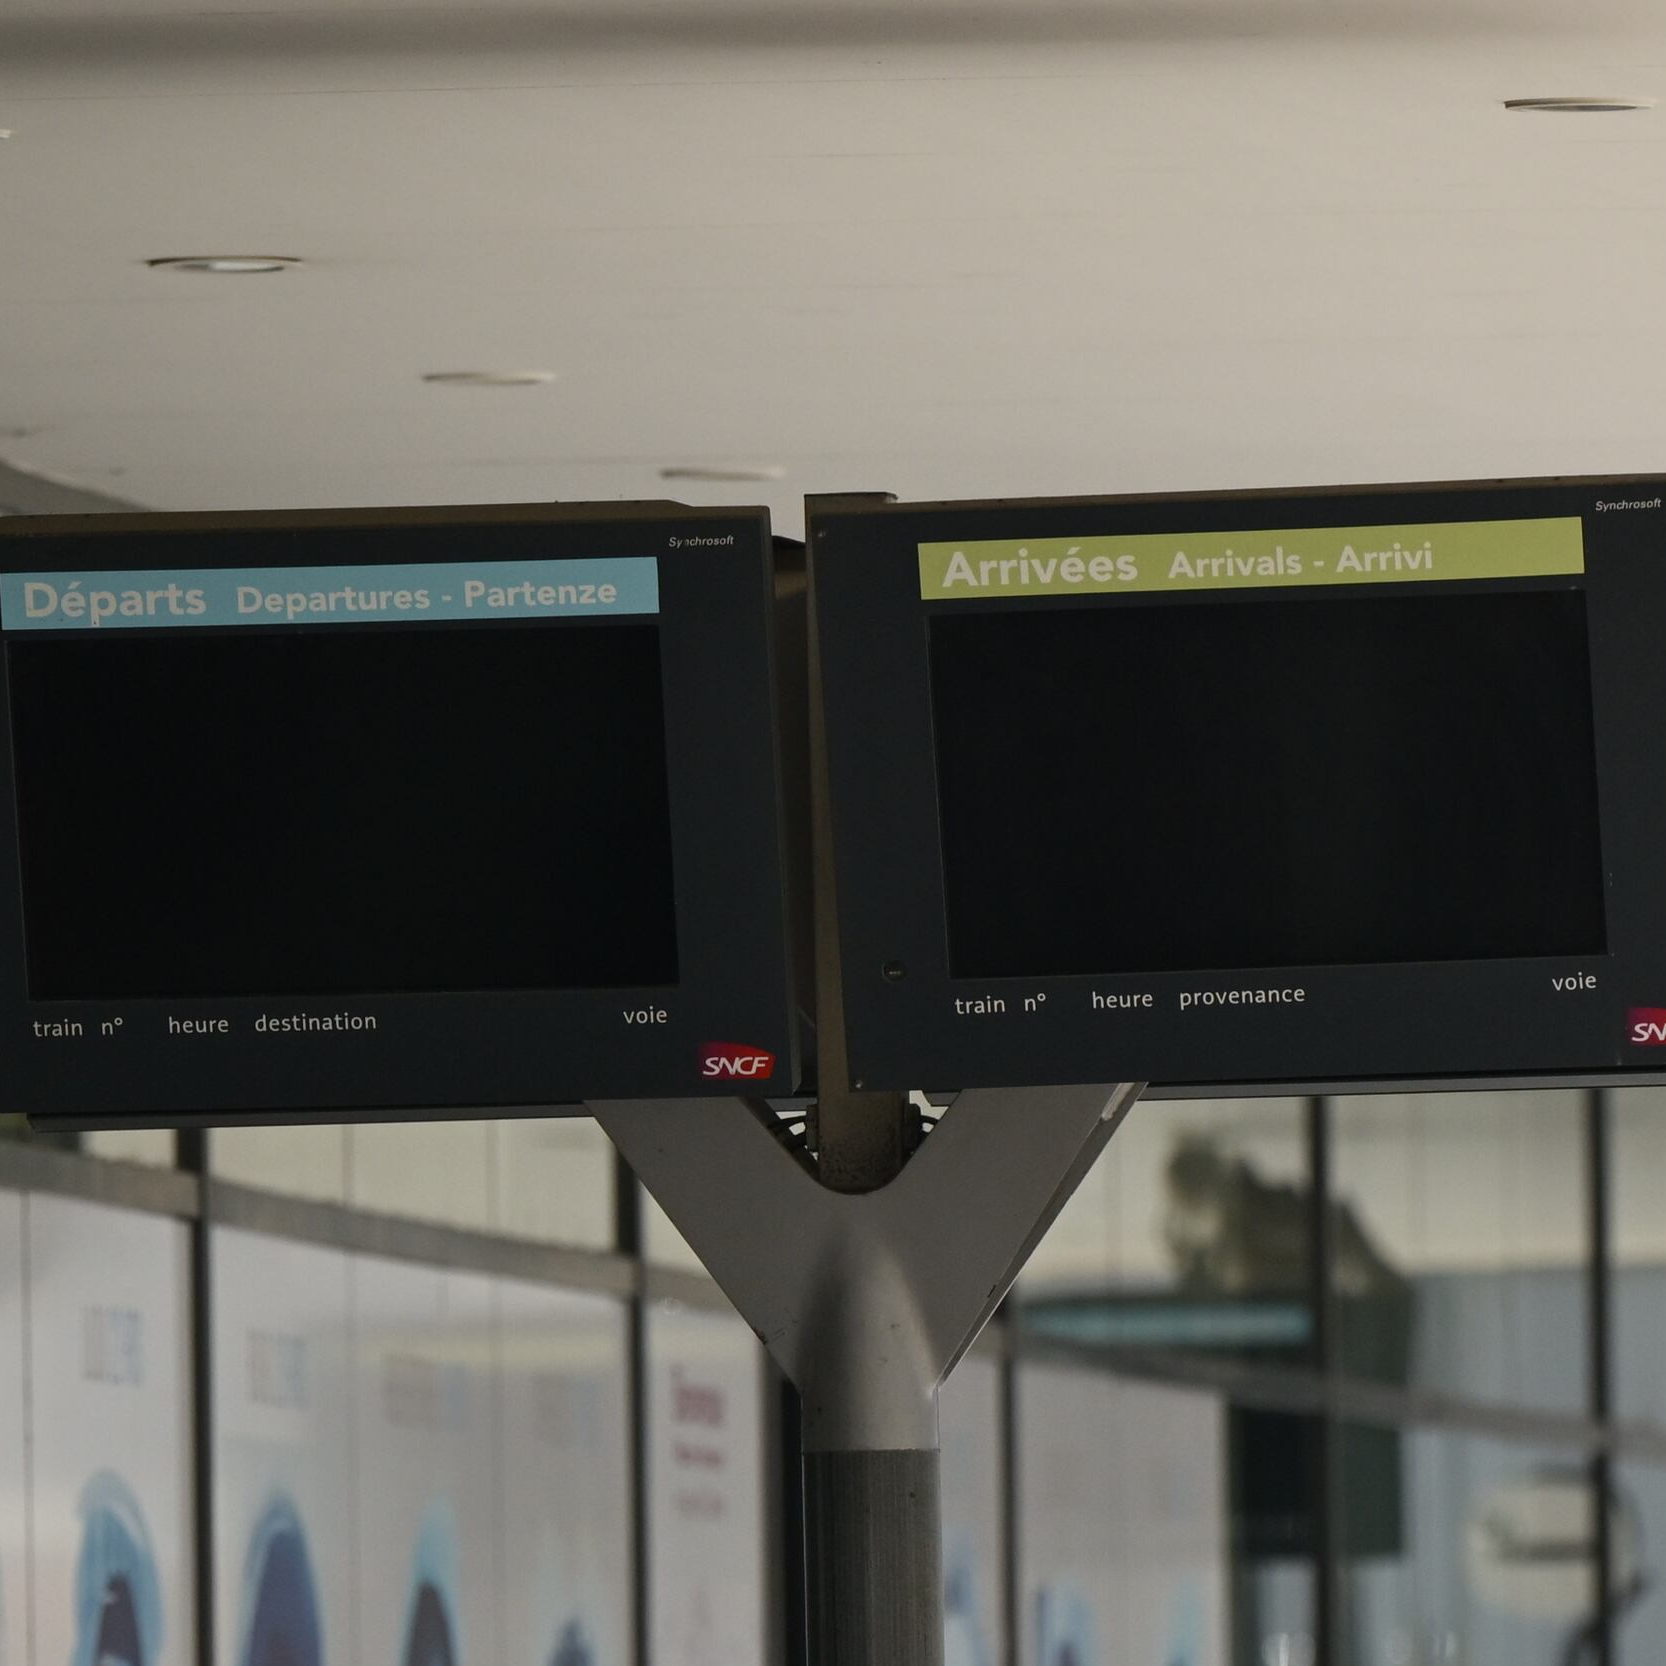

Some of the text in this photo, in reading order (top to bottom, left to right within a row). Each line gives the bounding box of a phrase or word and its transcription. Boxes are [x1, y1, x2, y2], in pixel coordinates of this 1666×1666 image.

[1595, 496, 1662, 515] Synchrosoft
[940, 545, 1139, 588] Arrivées
[1167, 545, 1303, 580] Arrivals
[1335, 541, 1434, 574] Arrivi
[23, 581, 208, 628] Départs
[236, 586, 432, 621] Departures
[464, 580, 619, 609] Partenze
[1550, 971, 1598, 992] voie
[953, 991, 1048, 1016] train n°
[1091, 988, 1154, 1010] heure
[1178, 986, 1306, 1011] provenance
[168, 1015, 230, 1035] heure
[253, 1011, 378, 1033] destination
[622, 1005, 669, 1025] voie
[32, 1016, 125, 1038] train n°
[701, 1055, 770, 1077] SNCF
